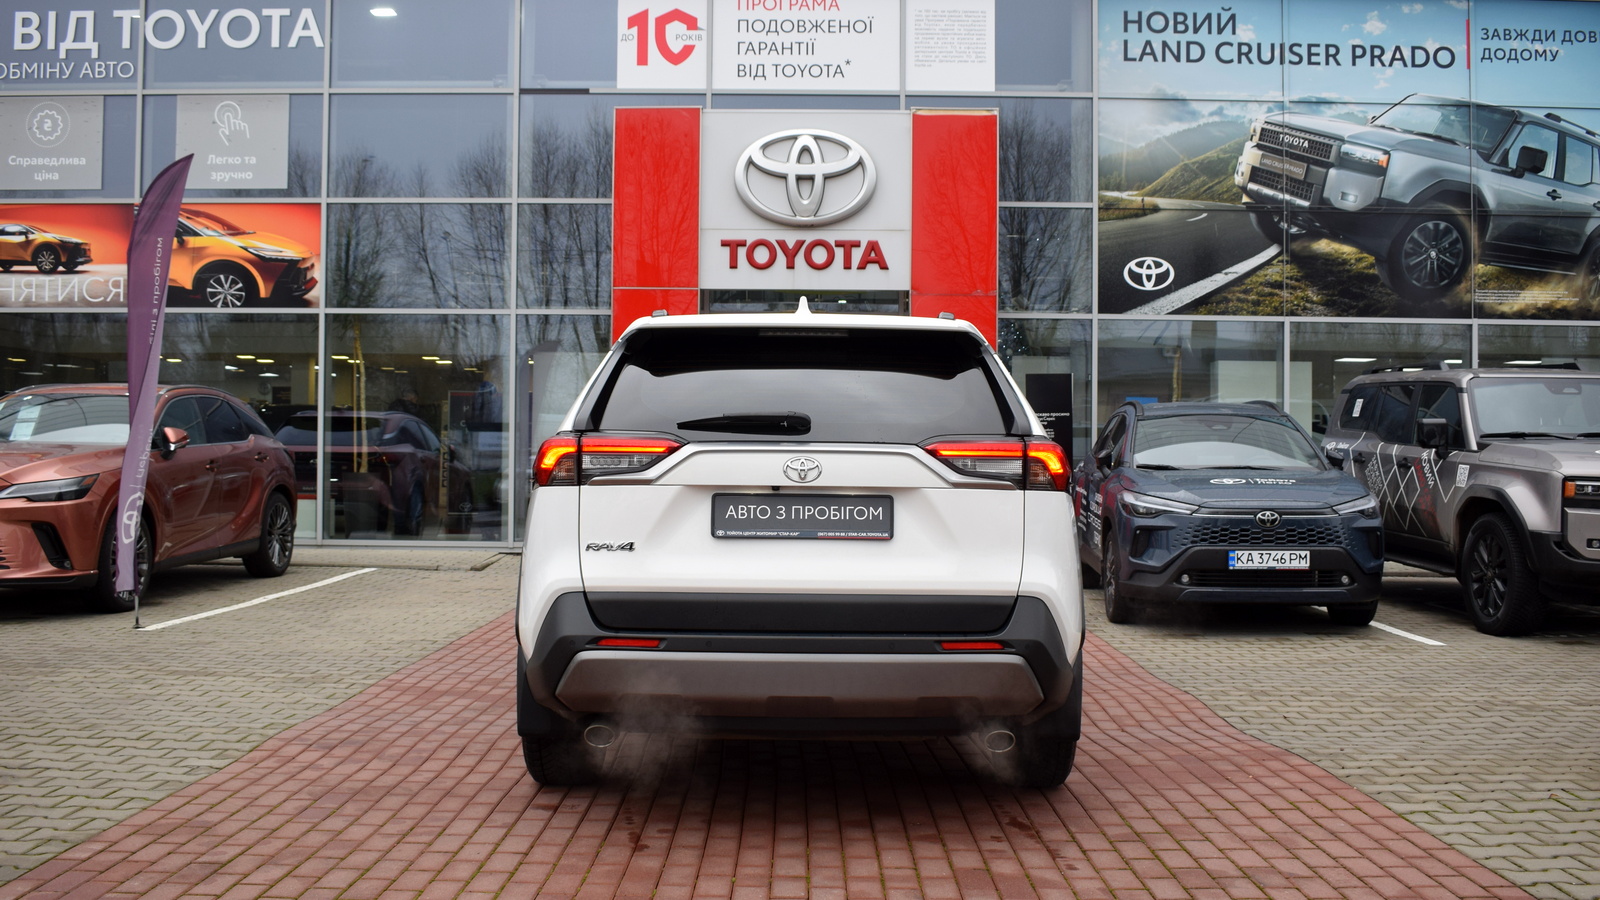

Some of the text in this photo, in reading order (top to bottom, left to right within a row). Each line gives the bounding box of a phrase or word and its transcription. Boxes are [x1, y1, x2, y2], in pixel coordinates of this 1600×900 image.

[737, 0, 840, 11] ПРОГРАМА
[737, 16, 875, 36] ПОДОВЖЕНОЇ
[1123, 6, 1237, 35] НОВИЙ
[13, 8, 325, 59] ВІД TOYOTA
[675, 33, 703, 42] РОКІВ
[1480, 28, 1600, 45] ЗАВЖДИ ДОВ
[737, 38, 817, 55] ГАРАНТІЇ
[1123, 39, 1456, 69] LAND CRUISER PRADO
[1480, 48, 1560, 64] ДОДОМУ
[79, 61, 135, 79] АВТО
[737, 63, 767, 81] ВІД
[1279, 134, 1309, 149] TOYOTA
[8, 155, 87, 168] Справедлива
[206, 154, 257, 165] Легко та
[34, 170, 60, 182] ціна
[210, 171, 254, 182] зручно
[720, 238, 890, 271] TOYOTA
[153, 237, 164, 305] пробігом
[725, 504, 883, 521] АВТО З ПРОБІГОМ
[585, 541, 636, 553] RAV4
[1236, 552, 1308, 565] KA 3746 PM
